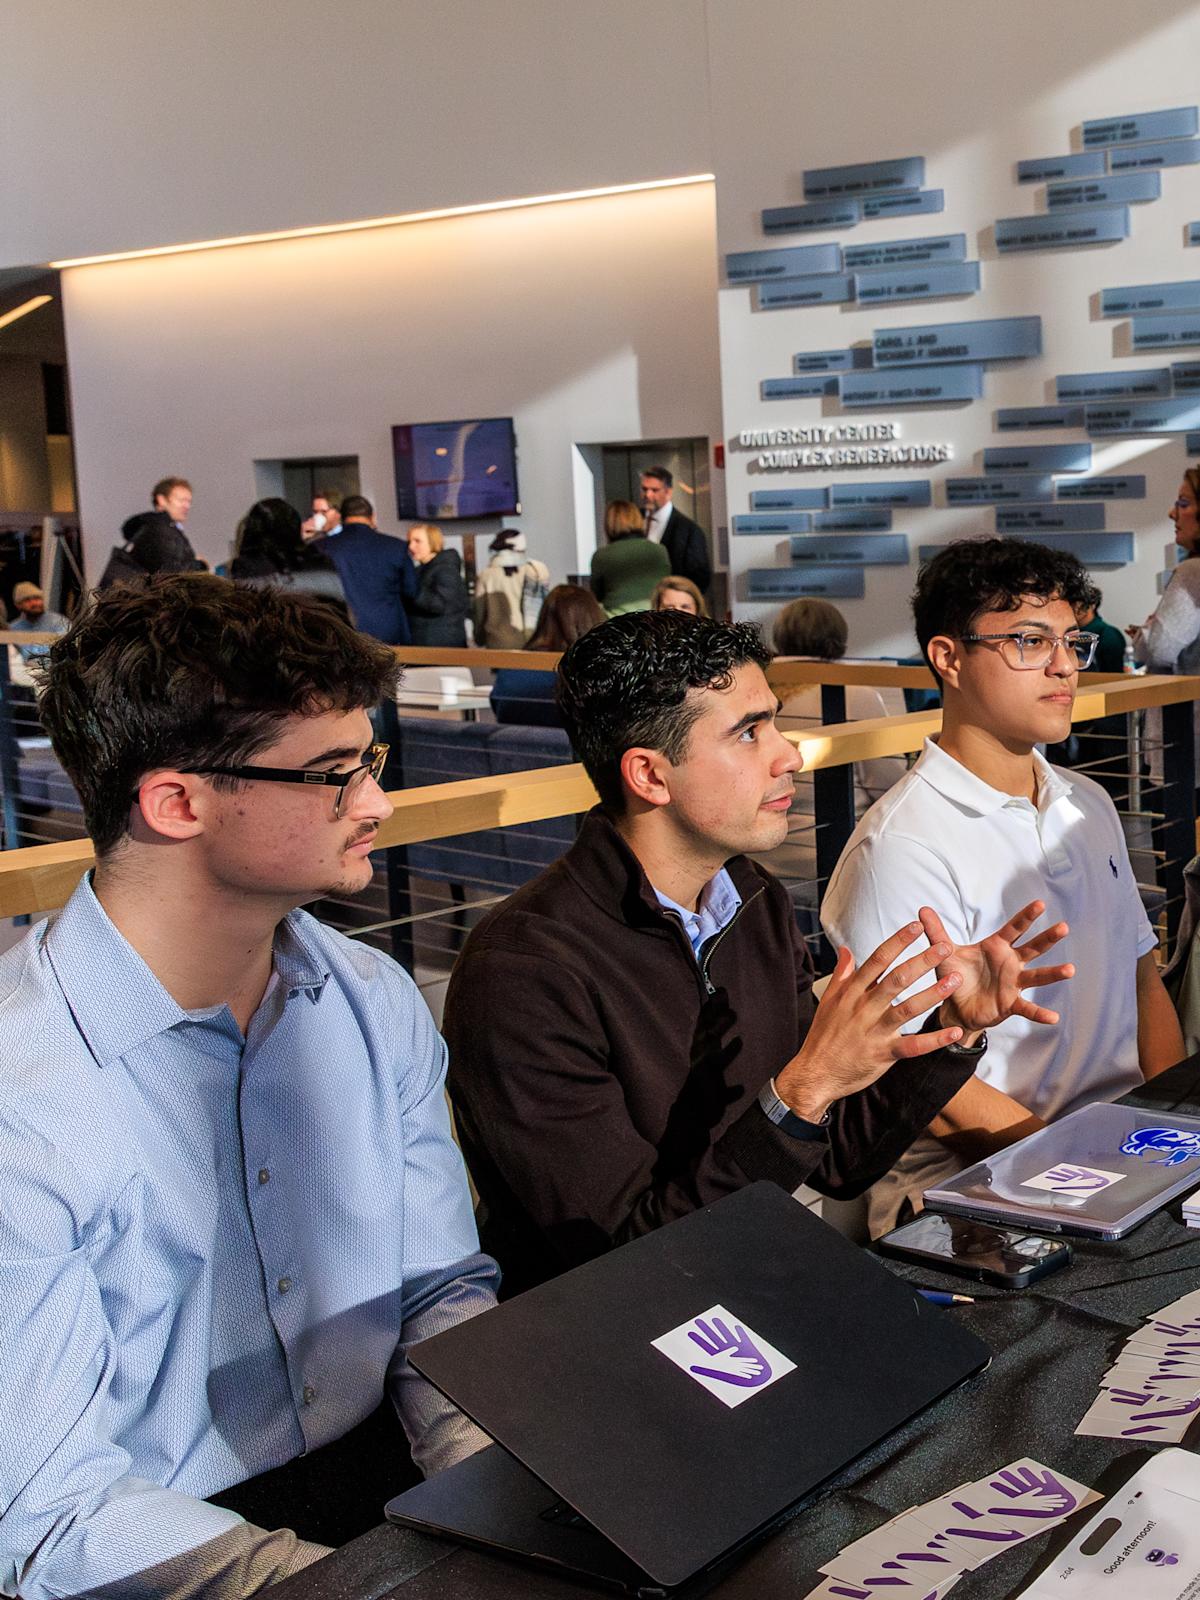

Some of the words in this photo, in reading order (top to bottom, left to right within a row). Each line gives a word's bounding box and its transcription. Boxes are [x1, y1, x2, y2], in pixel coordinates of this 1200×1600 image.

[739, 425, 833, 447] UNIVERSITY
[835, 421, 902, 442] CENTER
[758, 446, 833, 468] COMPLEX
[835, 443, 954, 466] BENEFACTORS
[1103, 1555, 1126, 1575] Good
[1122, 1520, 1156, 1557] afternoon!
[1060, 1566, 1075, 1580] 2:04
